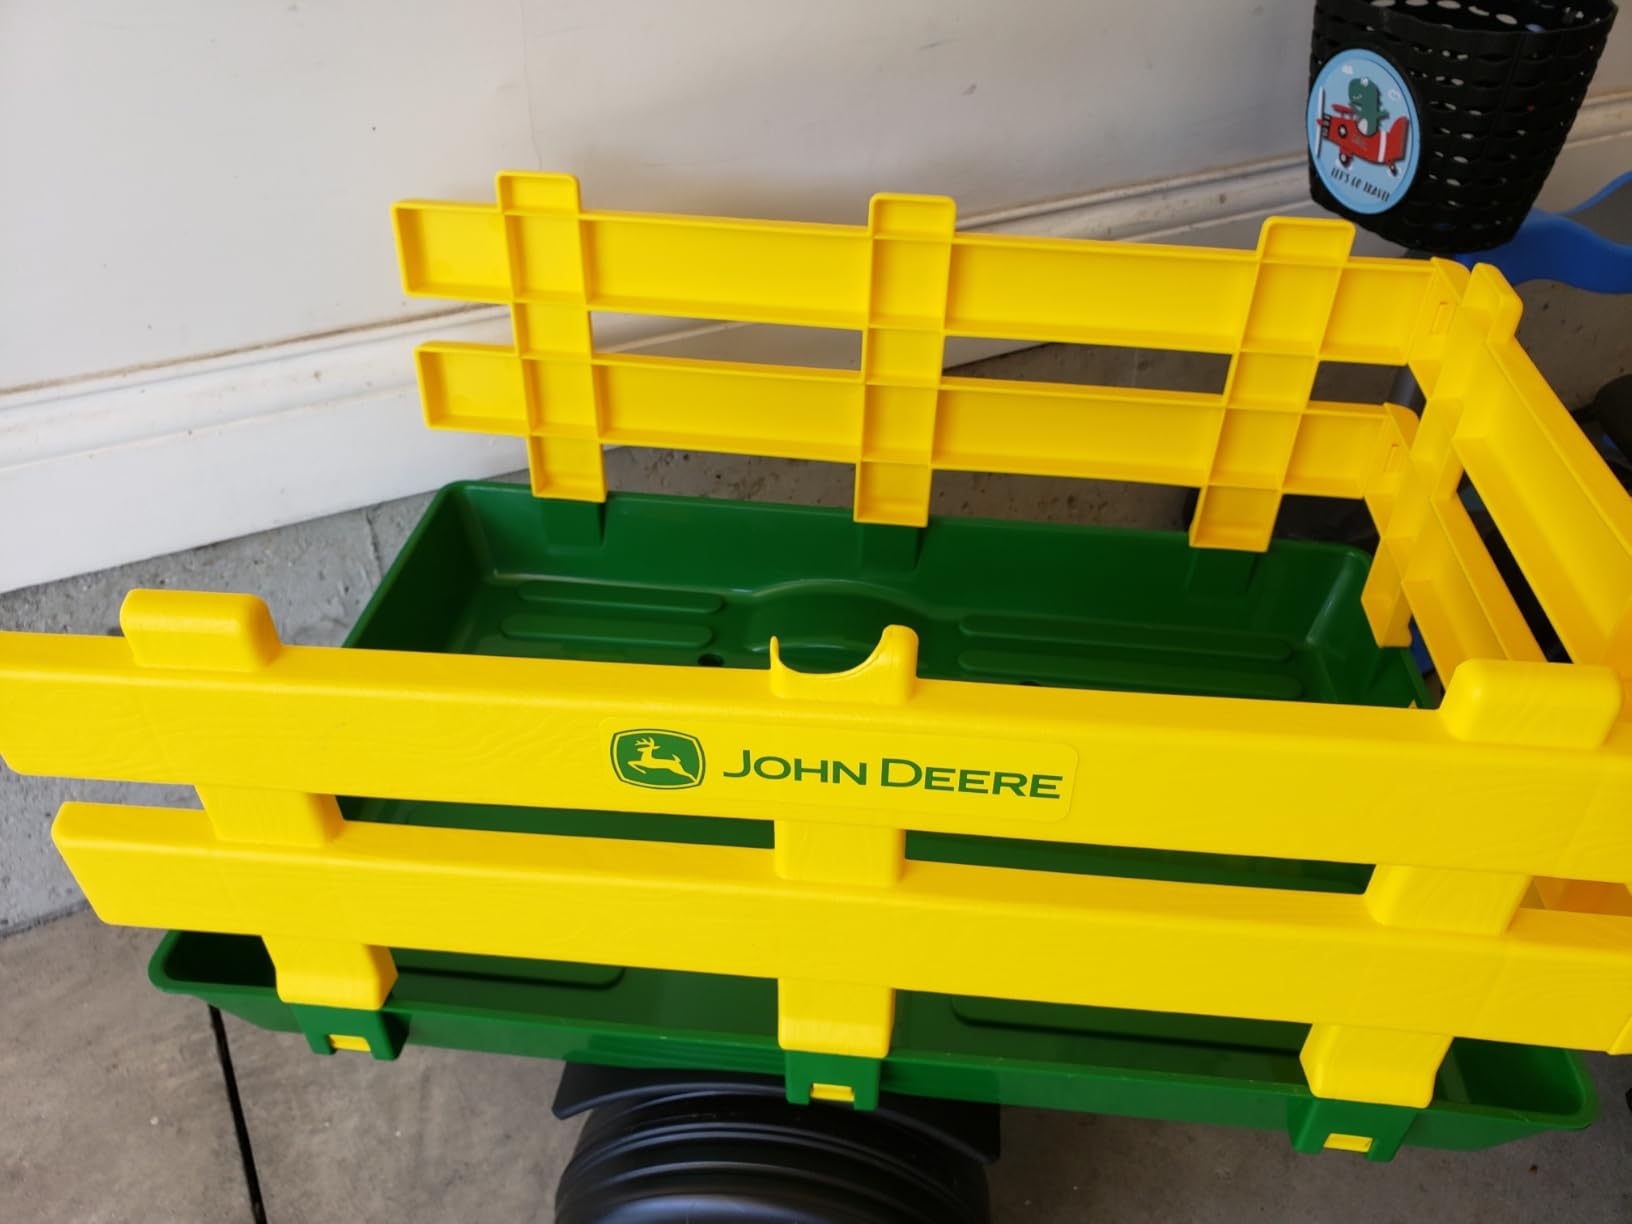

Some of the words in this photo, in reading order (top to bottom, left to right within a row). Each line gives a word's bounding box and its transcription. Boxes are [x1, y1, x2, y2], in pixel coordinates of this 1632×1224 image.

[1351, 176, 1362, 189] GO
[1363, 181, 1391, 202] TRAVEL
[723, 749, 867, 785] JOHN
[880, 758, 1063, 799] DEERE
